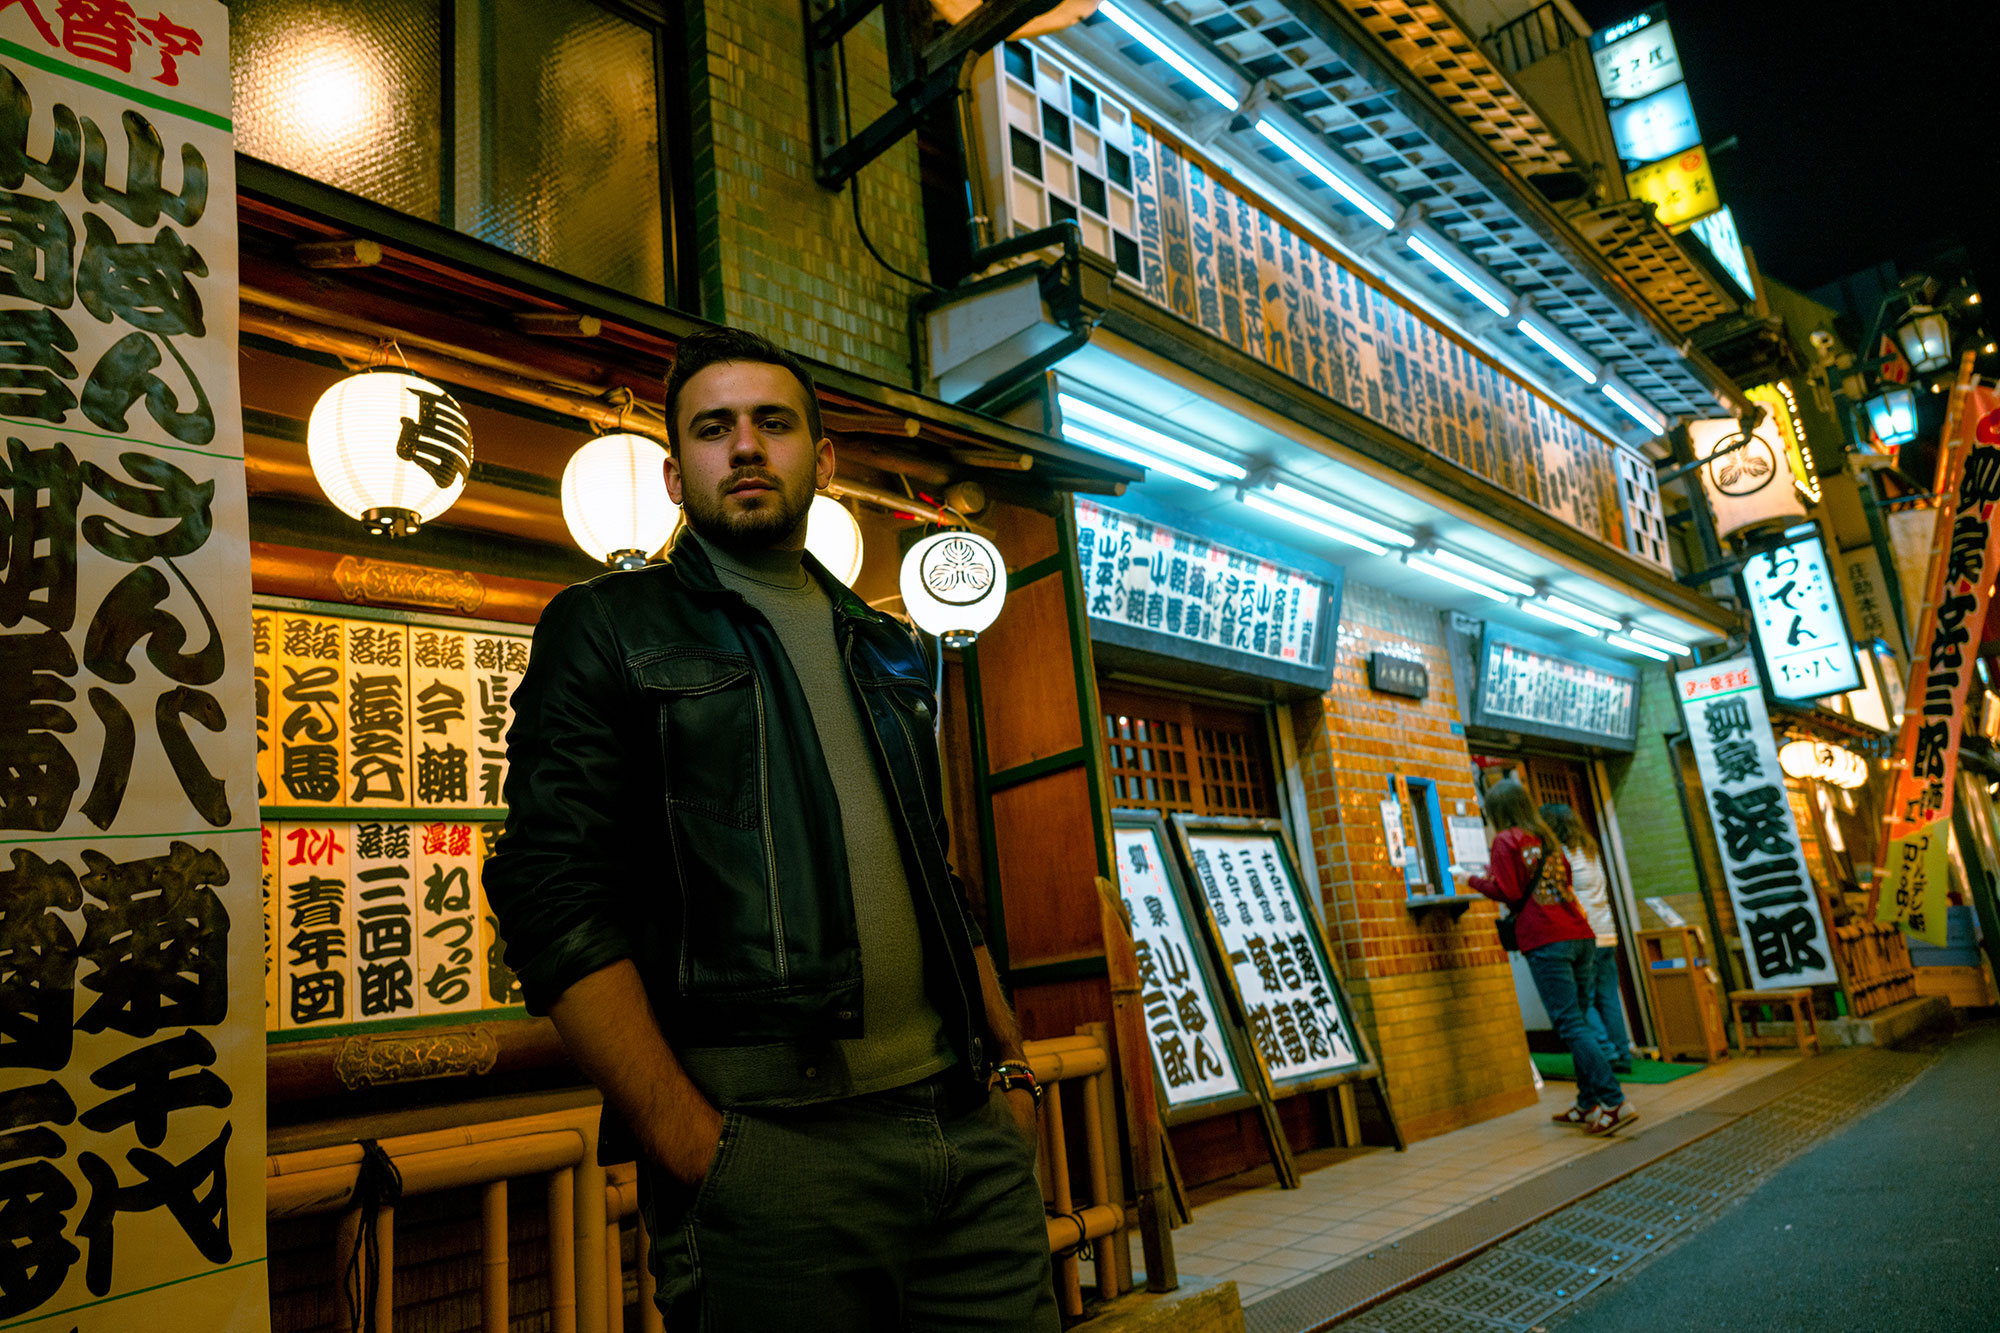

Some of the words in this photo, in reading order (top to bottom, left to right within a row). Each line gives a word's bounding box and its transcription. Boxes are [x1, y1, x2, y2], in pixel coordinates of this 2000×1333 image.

[1763, 545, 1818, 646] おでん
[282, 618, 341, 661] 落語
[348, 626, 403, 668] 落語
[413, 631, 466, 671] 落語
[281, 665, 341, 803] とん馬
[355, 823, 411, 860] 落語
[421, 822, 472, 857] 漫談
[287, 875, 347, 1025] 青年団
[357, 864, 413, 1017] 三四郎
[423, 862, 474, 1005] ねづっち
